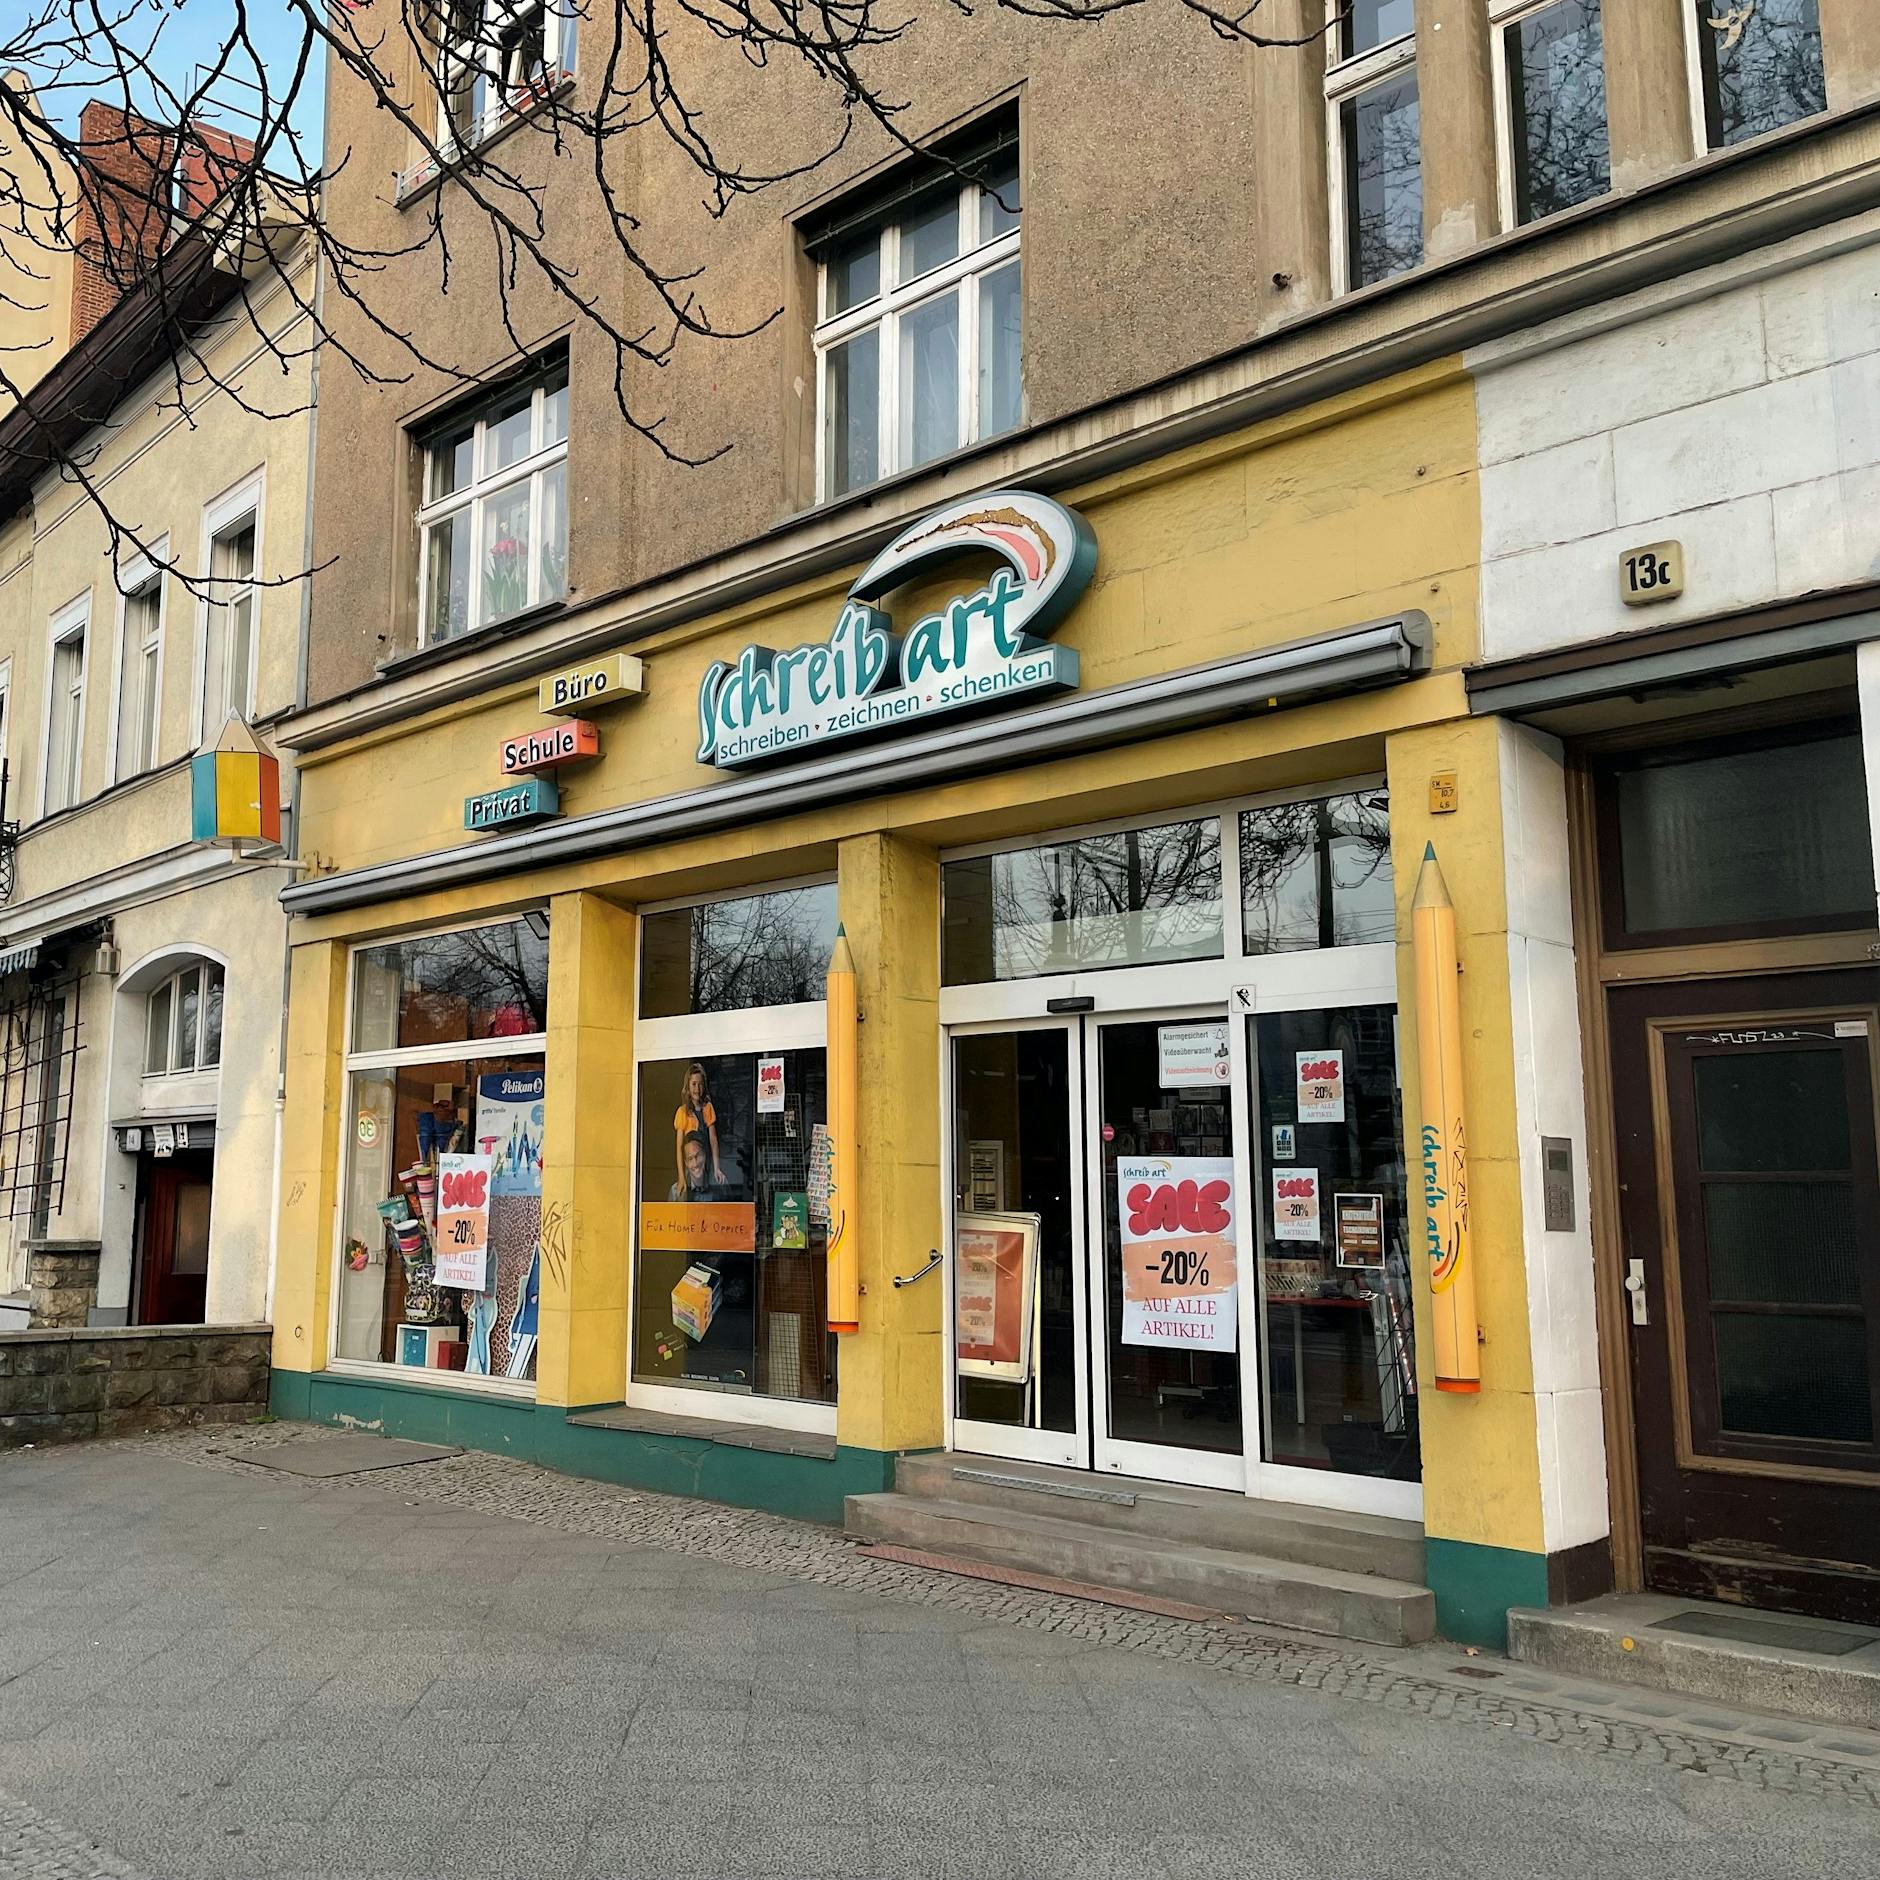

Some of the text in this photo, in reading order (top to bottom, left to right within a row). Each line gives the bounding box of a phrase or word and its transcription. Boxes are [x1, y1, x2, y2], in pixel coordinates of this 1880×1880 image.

[1625, 553, 1671, 591] 13c
[908, 576, 1024, 683] art
[554, 671, 607, 705] Büro
[720, 659, 1052, 760] schreiben zeichnen schenken
[505, 730, 574, 769] Schule
[471, 789, 530, 824] Privat
[1163, 1031, 1209, 1041] Alarmgesichert
[1163, 1047, 1212, 1056] Videoüberwacht
[1301, 1060, 1340, 1082] SALE
[501, 1078, 533, 1094] Pelikan
[1308, 1086, 1333, 1099] -20%
[1151, 1168, 1166, 1177] art
[443, 1170, 487, 1209] SALE
[1277, 1178, 1315, 1198] SALE
[1126, 1179, 1232, 1236] SALE
[1285, 1203, 1309, 1217] -20%
[448, 1219, 476, 1245] -20%
[646, 1219, 663, 1232] FÜR
[668, 1221, 695, 1233] HOME
[700, 1219, 707, 1233] &
[1426, 1216, 1445, 1262] art
[444, 1251, 478, 1266] AUF ALLE
[1145, 1250, 1210, 1287] -20%
[442, 1267, 476, 1282] ARTIKEL!
[1142, 1297, 1217, 1316] AUF ALLE
[1141, 1319, 1215, 1340] ARTIKEL!
